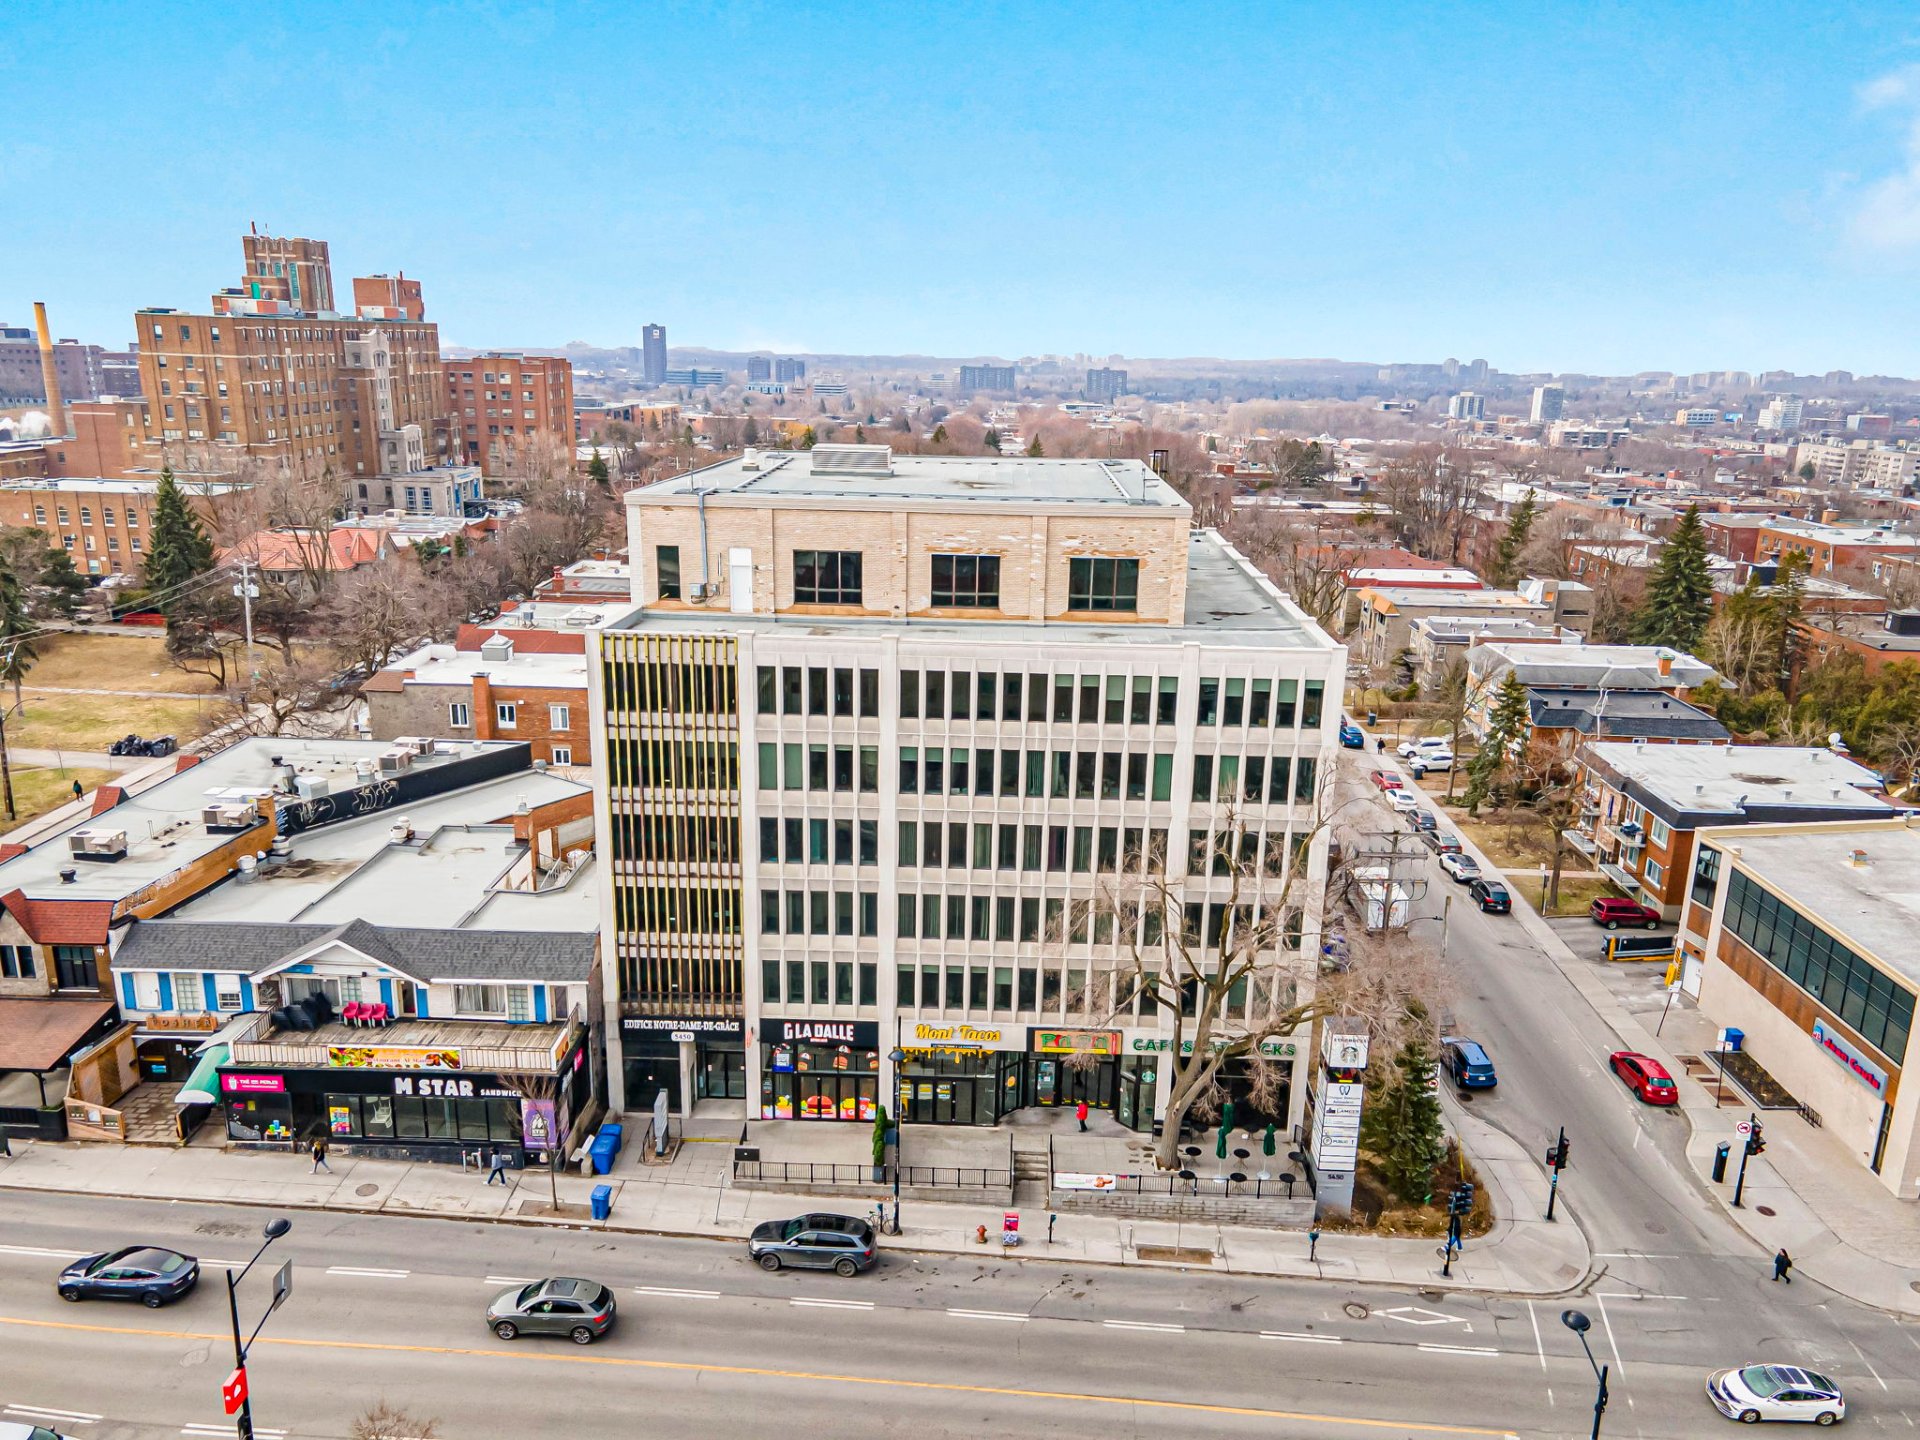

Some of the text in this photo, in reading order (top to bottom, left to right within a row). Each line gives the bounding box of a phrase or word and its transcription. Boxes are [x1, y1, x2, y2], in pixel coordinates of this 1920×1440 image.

[795, 1023, 812, 1039] LA
[813, 1023, 854, 1042] DALLE
[914, 1023, 1002, 1043] Mont Tacos
[393, 1077, 413, 1095] M
[417, 1078, 474, 1097] STAR
